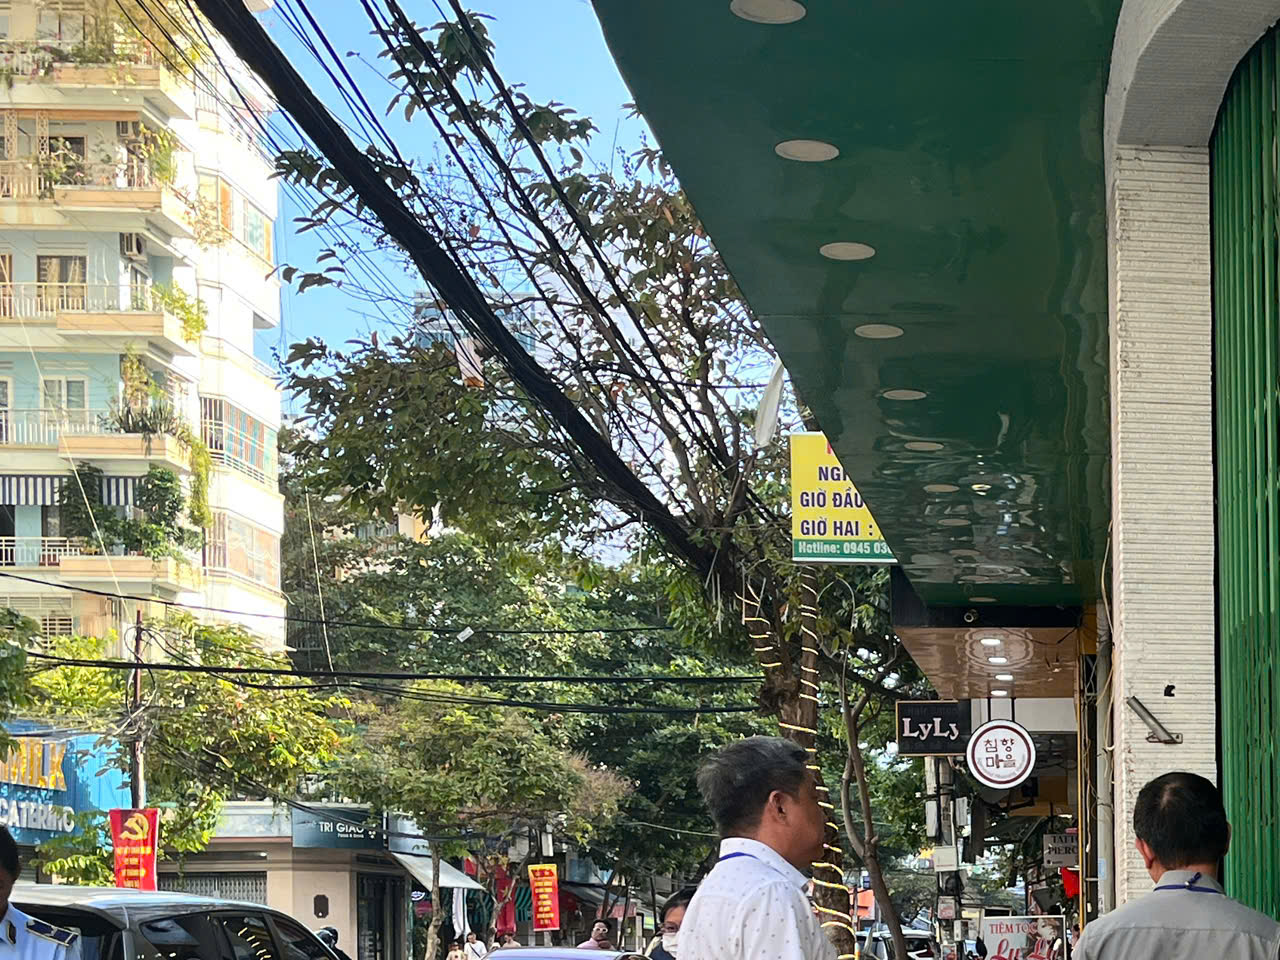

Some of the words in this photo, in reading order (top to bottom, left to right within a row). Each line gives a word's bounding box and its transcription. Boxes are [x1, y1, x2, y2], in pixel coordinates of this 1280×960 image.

[800, 487, 827, 508] GIỜ
[800, 516, 827, 536] GIỜ
[833, 520, 859, 536] HAI
[798, 541, 840, 554] Hotline:
[843, 541, 871, 554] 0945
[902, 717, 959, 740] LyLy
